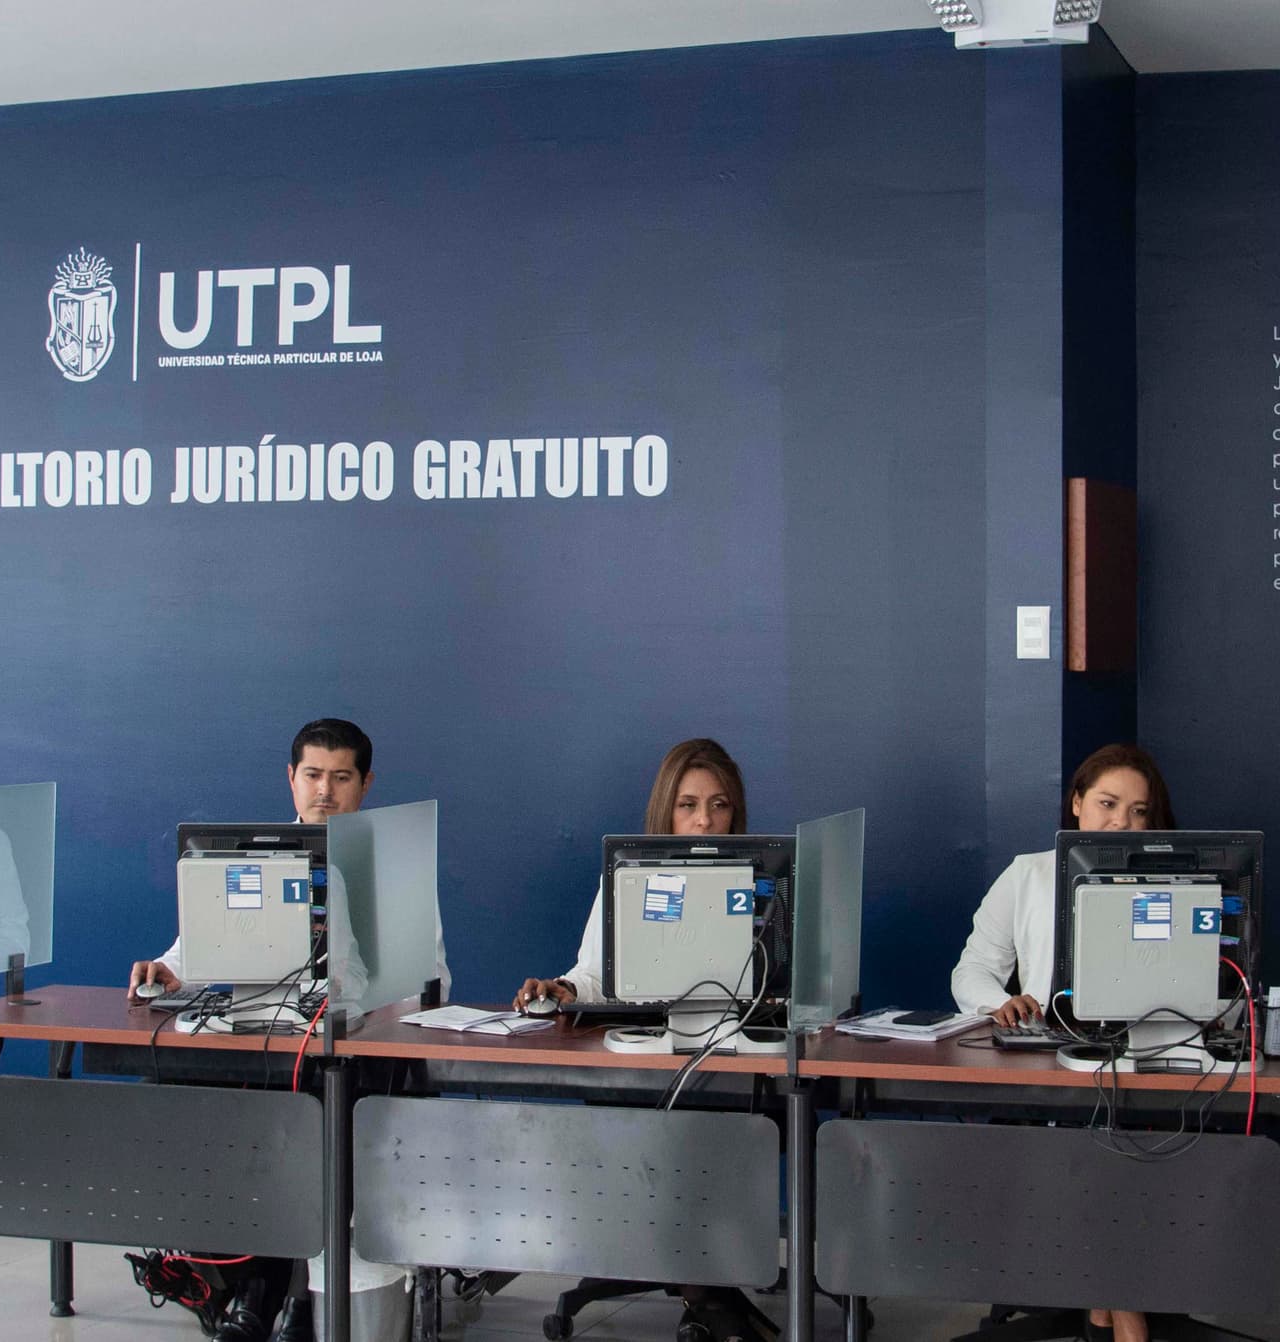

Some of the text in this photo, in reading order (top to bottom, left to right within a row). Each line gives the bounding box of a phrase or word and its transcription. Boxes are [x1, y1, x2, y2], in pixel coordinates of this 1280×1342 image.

[159, 264, 382, 349] UTPL
[158, 351, 383, 367] UNIVERSIDAD TÉCNICA PARTICULAR DE LOJA
[171, 434, 394, 504] JURÍDICO
[413, 435, 668, 500] GRATUITO
[291, 882, 301, 900] 1
[732, 892, 747, 912] 2
[1198, 911, 1214, 930] 3
